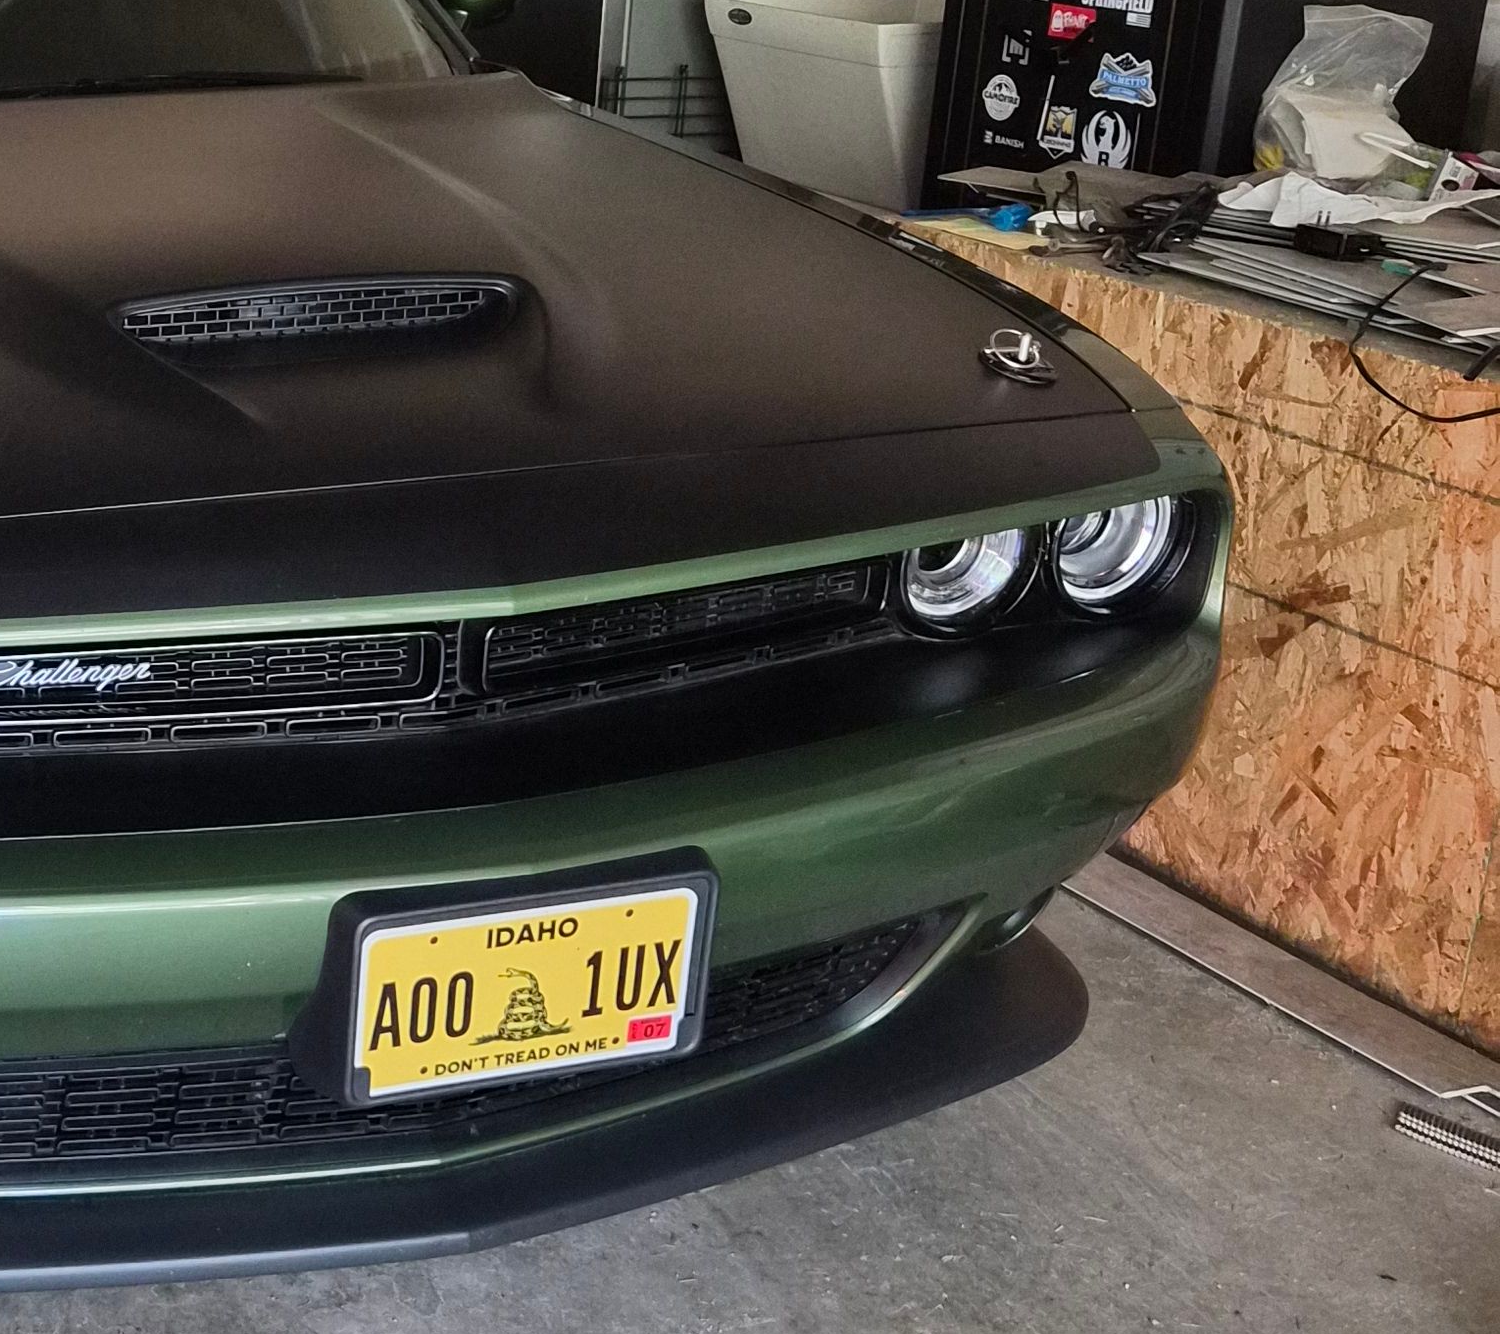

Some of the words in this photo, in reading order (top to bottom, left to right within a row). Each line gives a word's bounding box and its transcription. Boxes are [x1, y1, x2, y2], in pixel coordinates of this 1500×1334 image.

[1103, 70, 1147, 86] PALMETTO
[994, 134, 1025, 149] BANISH
[486, 917, 579, 949] IDAHO
[581, 939, 682, 1018] 1UX
[643, 1022, 667, 1038] 07
[435, 1056, 489, 1076] DON'T
[494, 1047, 550, 1066] TREAD
[555, 1041, 581, 1056] ON
[584, 1037, 608, 1051] ME
